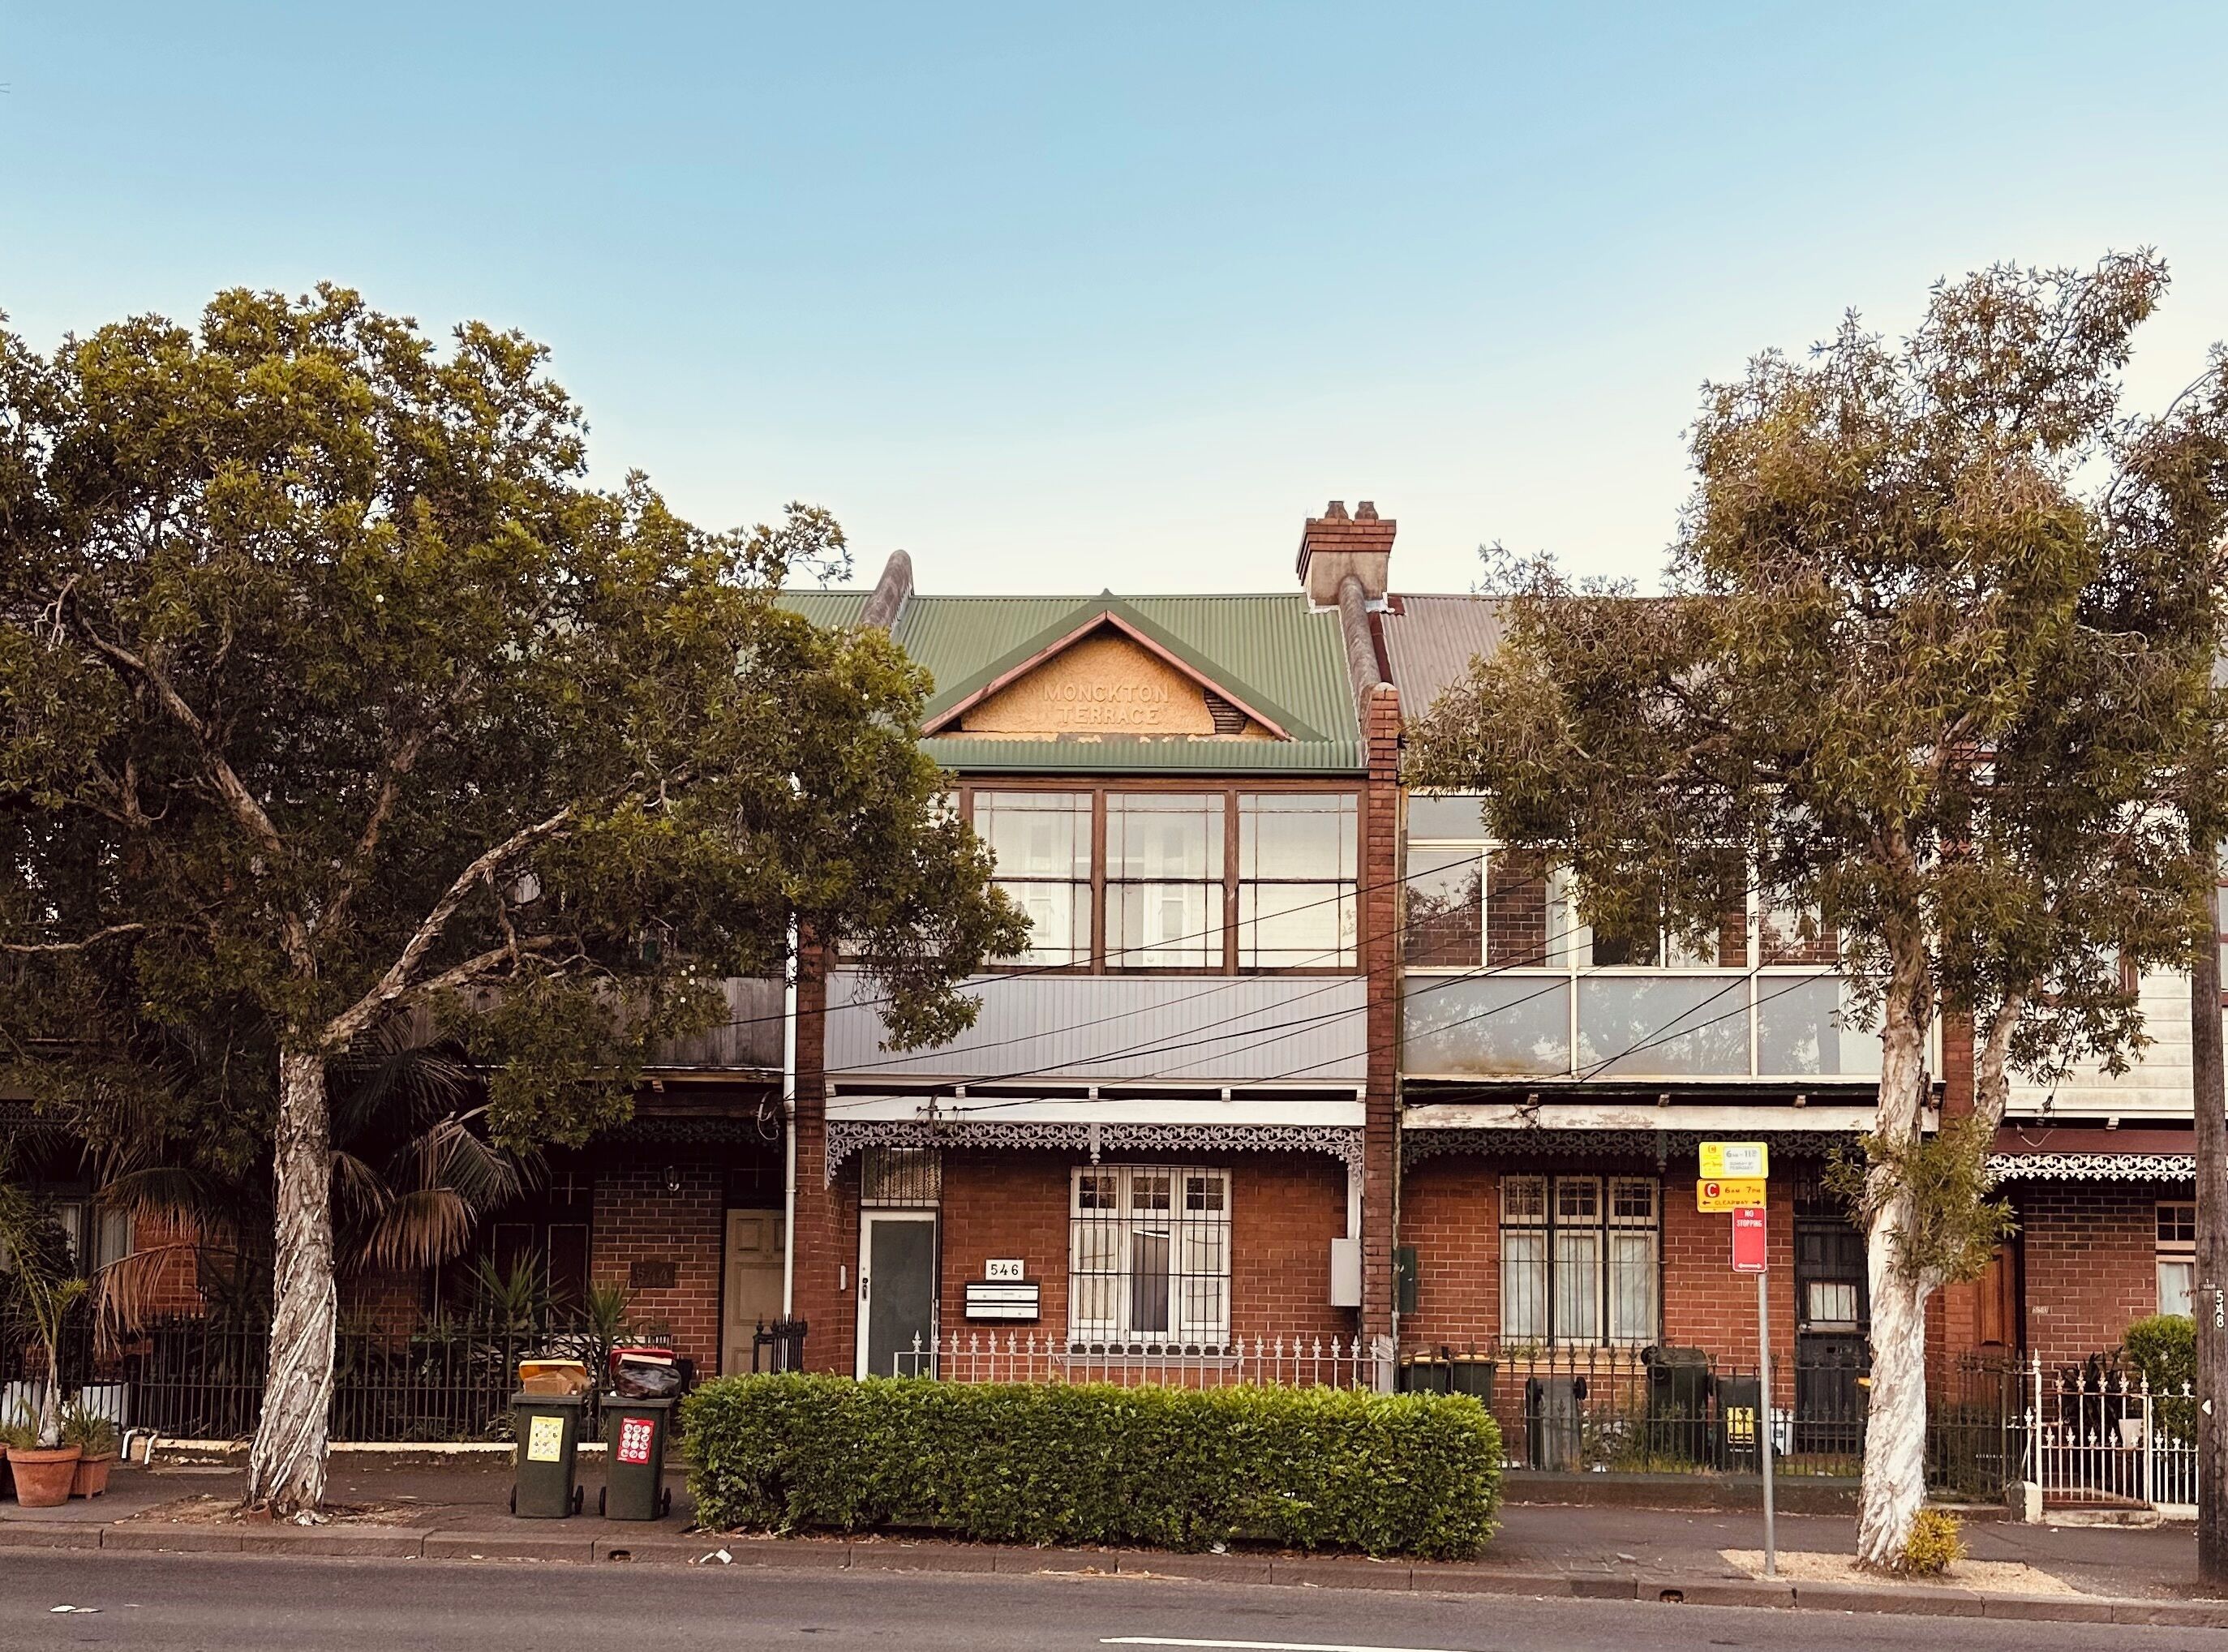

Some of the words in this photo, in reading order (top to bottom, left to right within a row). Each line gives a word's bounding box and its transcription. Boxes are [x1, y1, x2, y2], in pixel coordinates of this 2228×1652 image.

[1044, 683, 1169, 703] MONCKTON
[1058, 707, 1160, 725] TERRACE
[1707, 1183, 1717, 1197] C
[1744, 1209, 1754, 1217] NO
[1736, 1219, 1762, 1227] STOPPING
[990, 1264, 1019, 1276] 546
